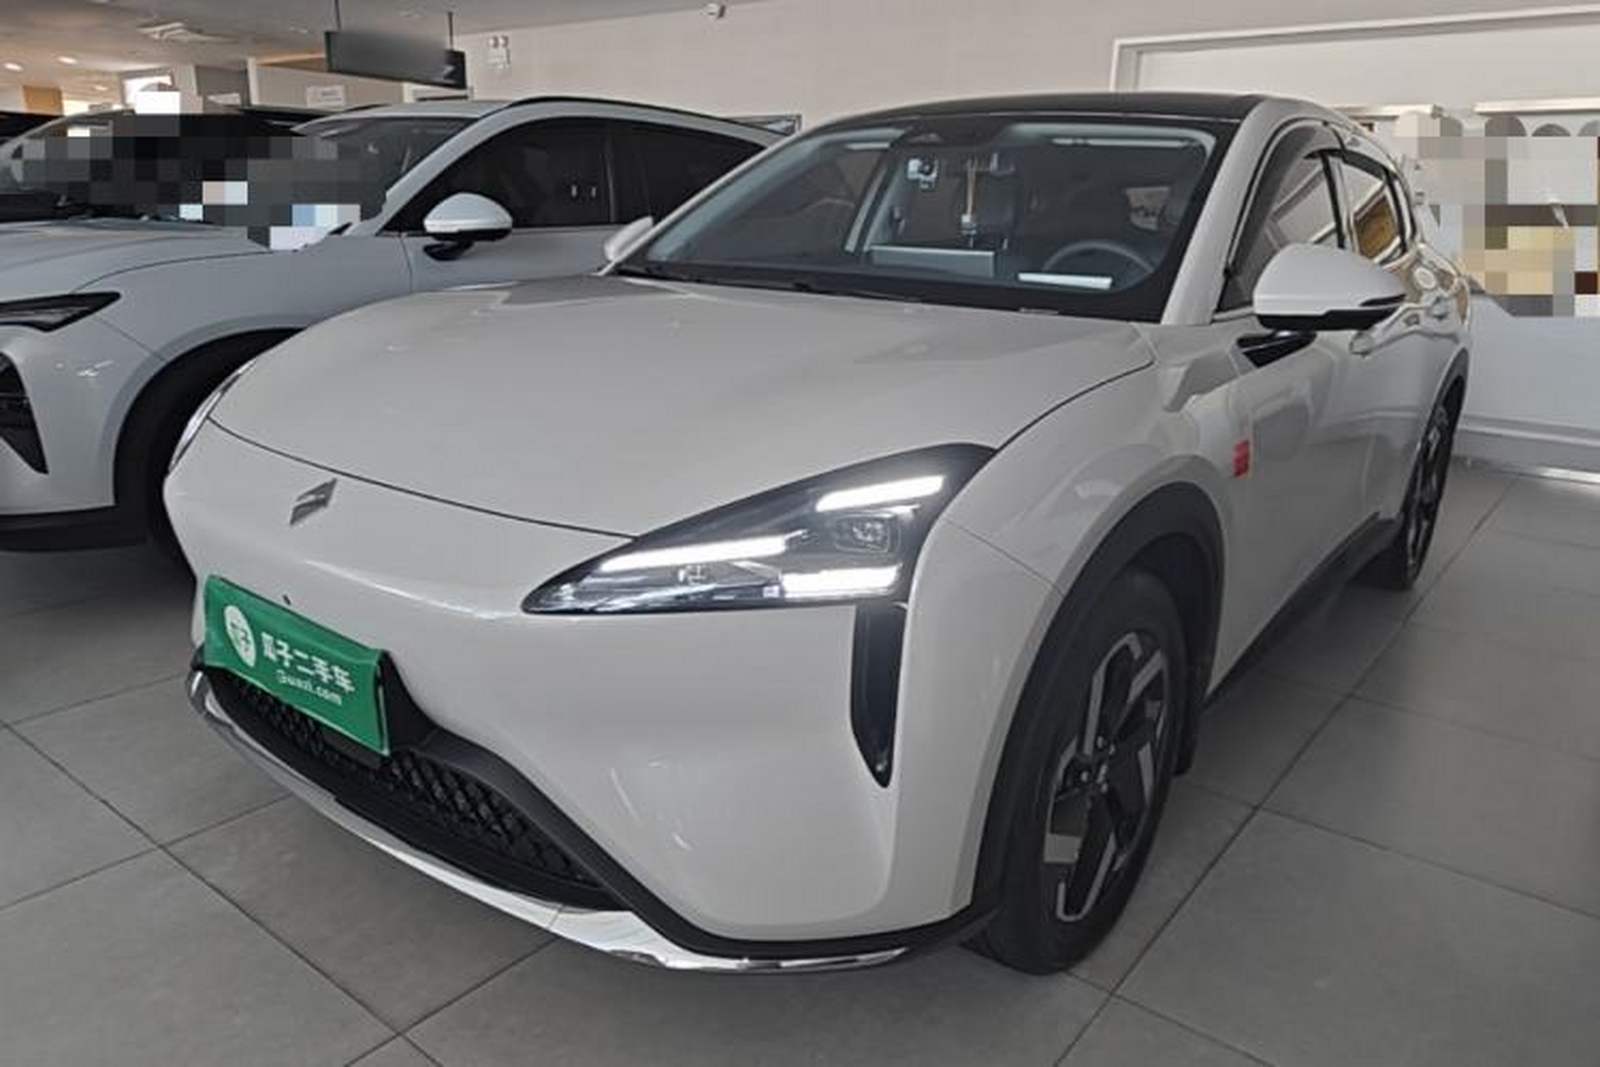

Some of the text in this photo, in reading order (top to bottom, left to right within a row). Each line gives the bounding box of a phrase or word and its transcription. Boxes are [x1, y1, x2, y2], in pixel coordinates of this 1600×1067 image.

[261, 632, 355, 694] 瓜子二手车
